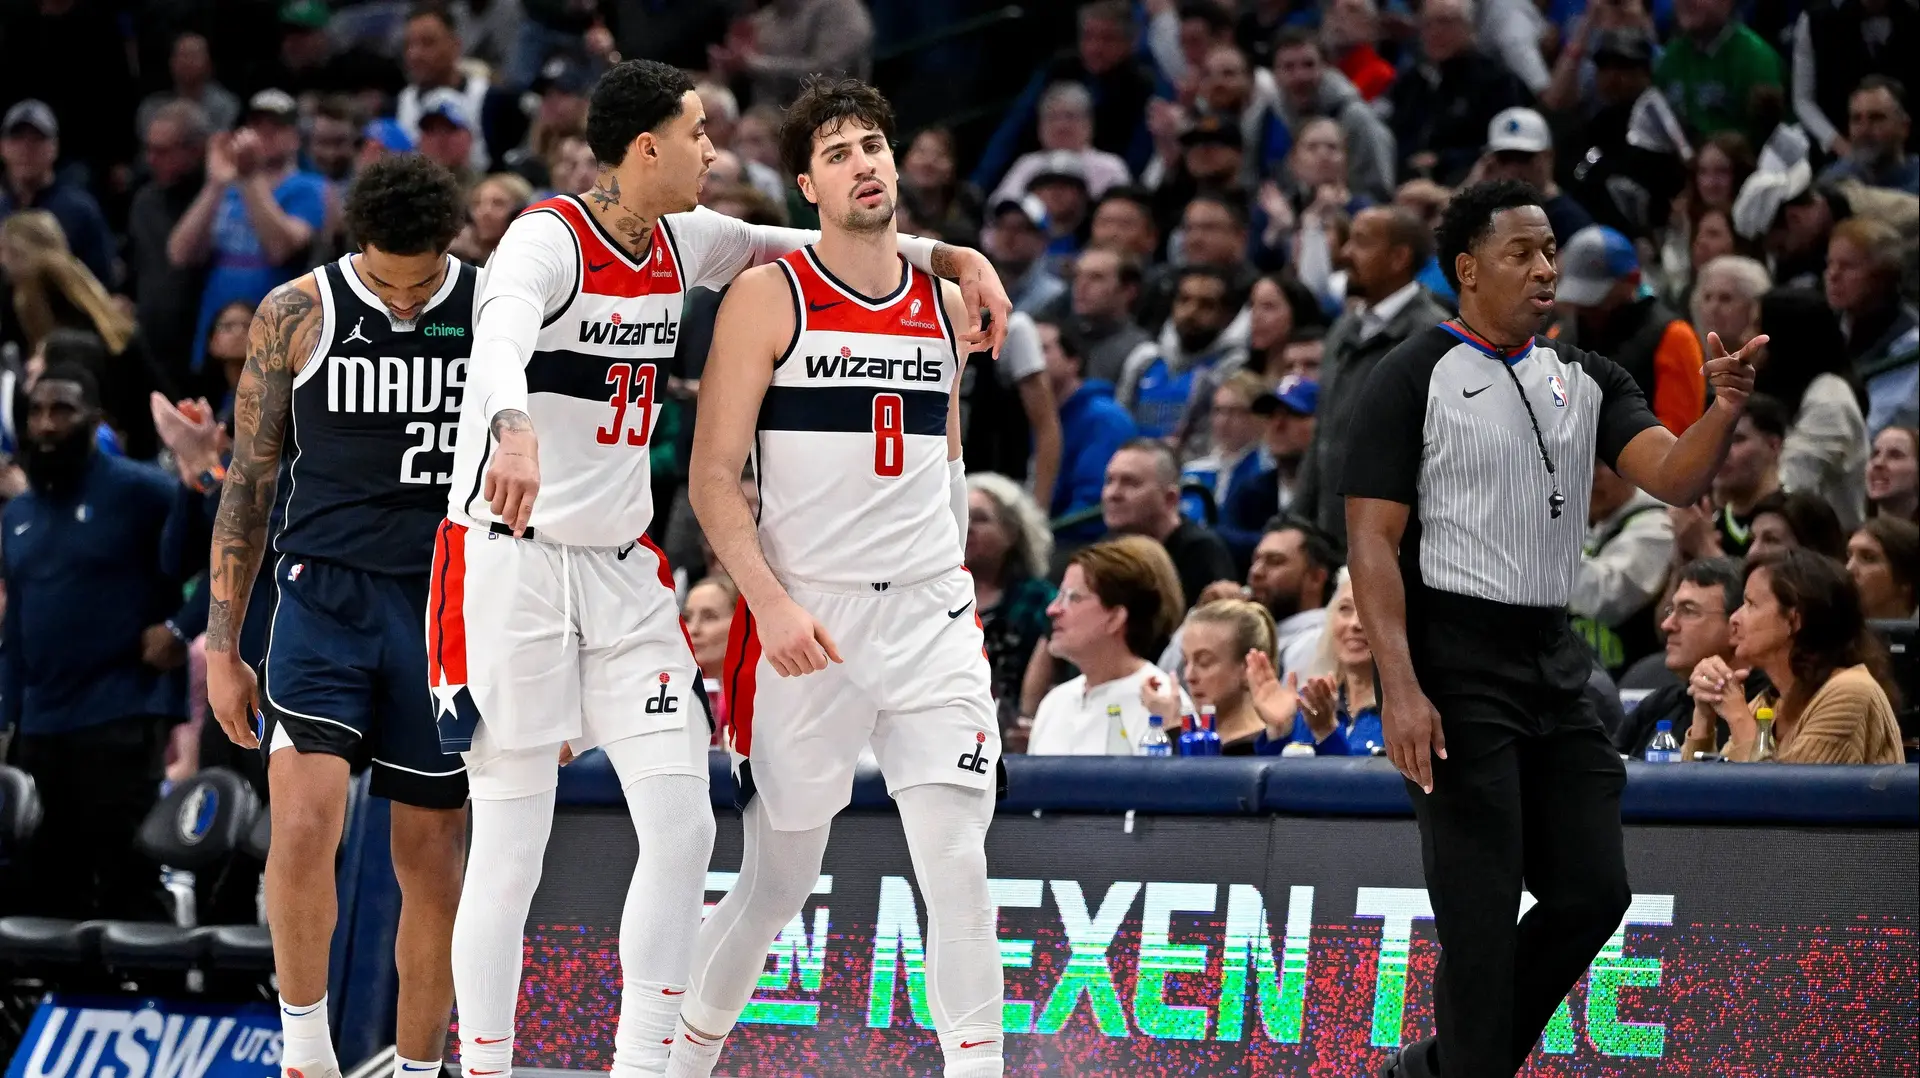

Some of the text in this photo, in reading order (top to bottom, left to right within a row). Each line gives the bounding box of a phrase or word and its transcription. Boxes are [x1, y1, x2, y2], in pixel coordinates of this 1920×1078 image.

[424, 323, 465, 337] chime
[901, 319, 936, 330] Robinhood
[327, 356, 471, 413] MAVS
[596, 362, 657, 447] 33
[872, 392, 905, 479] 8
[23, 1007, 237, 1078] UTSW
